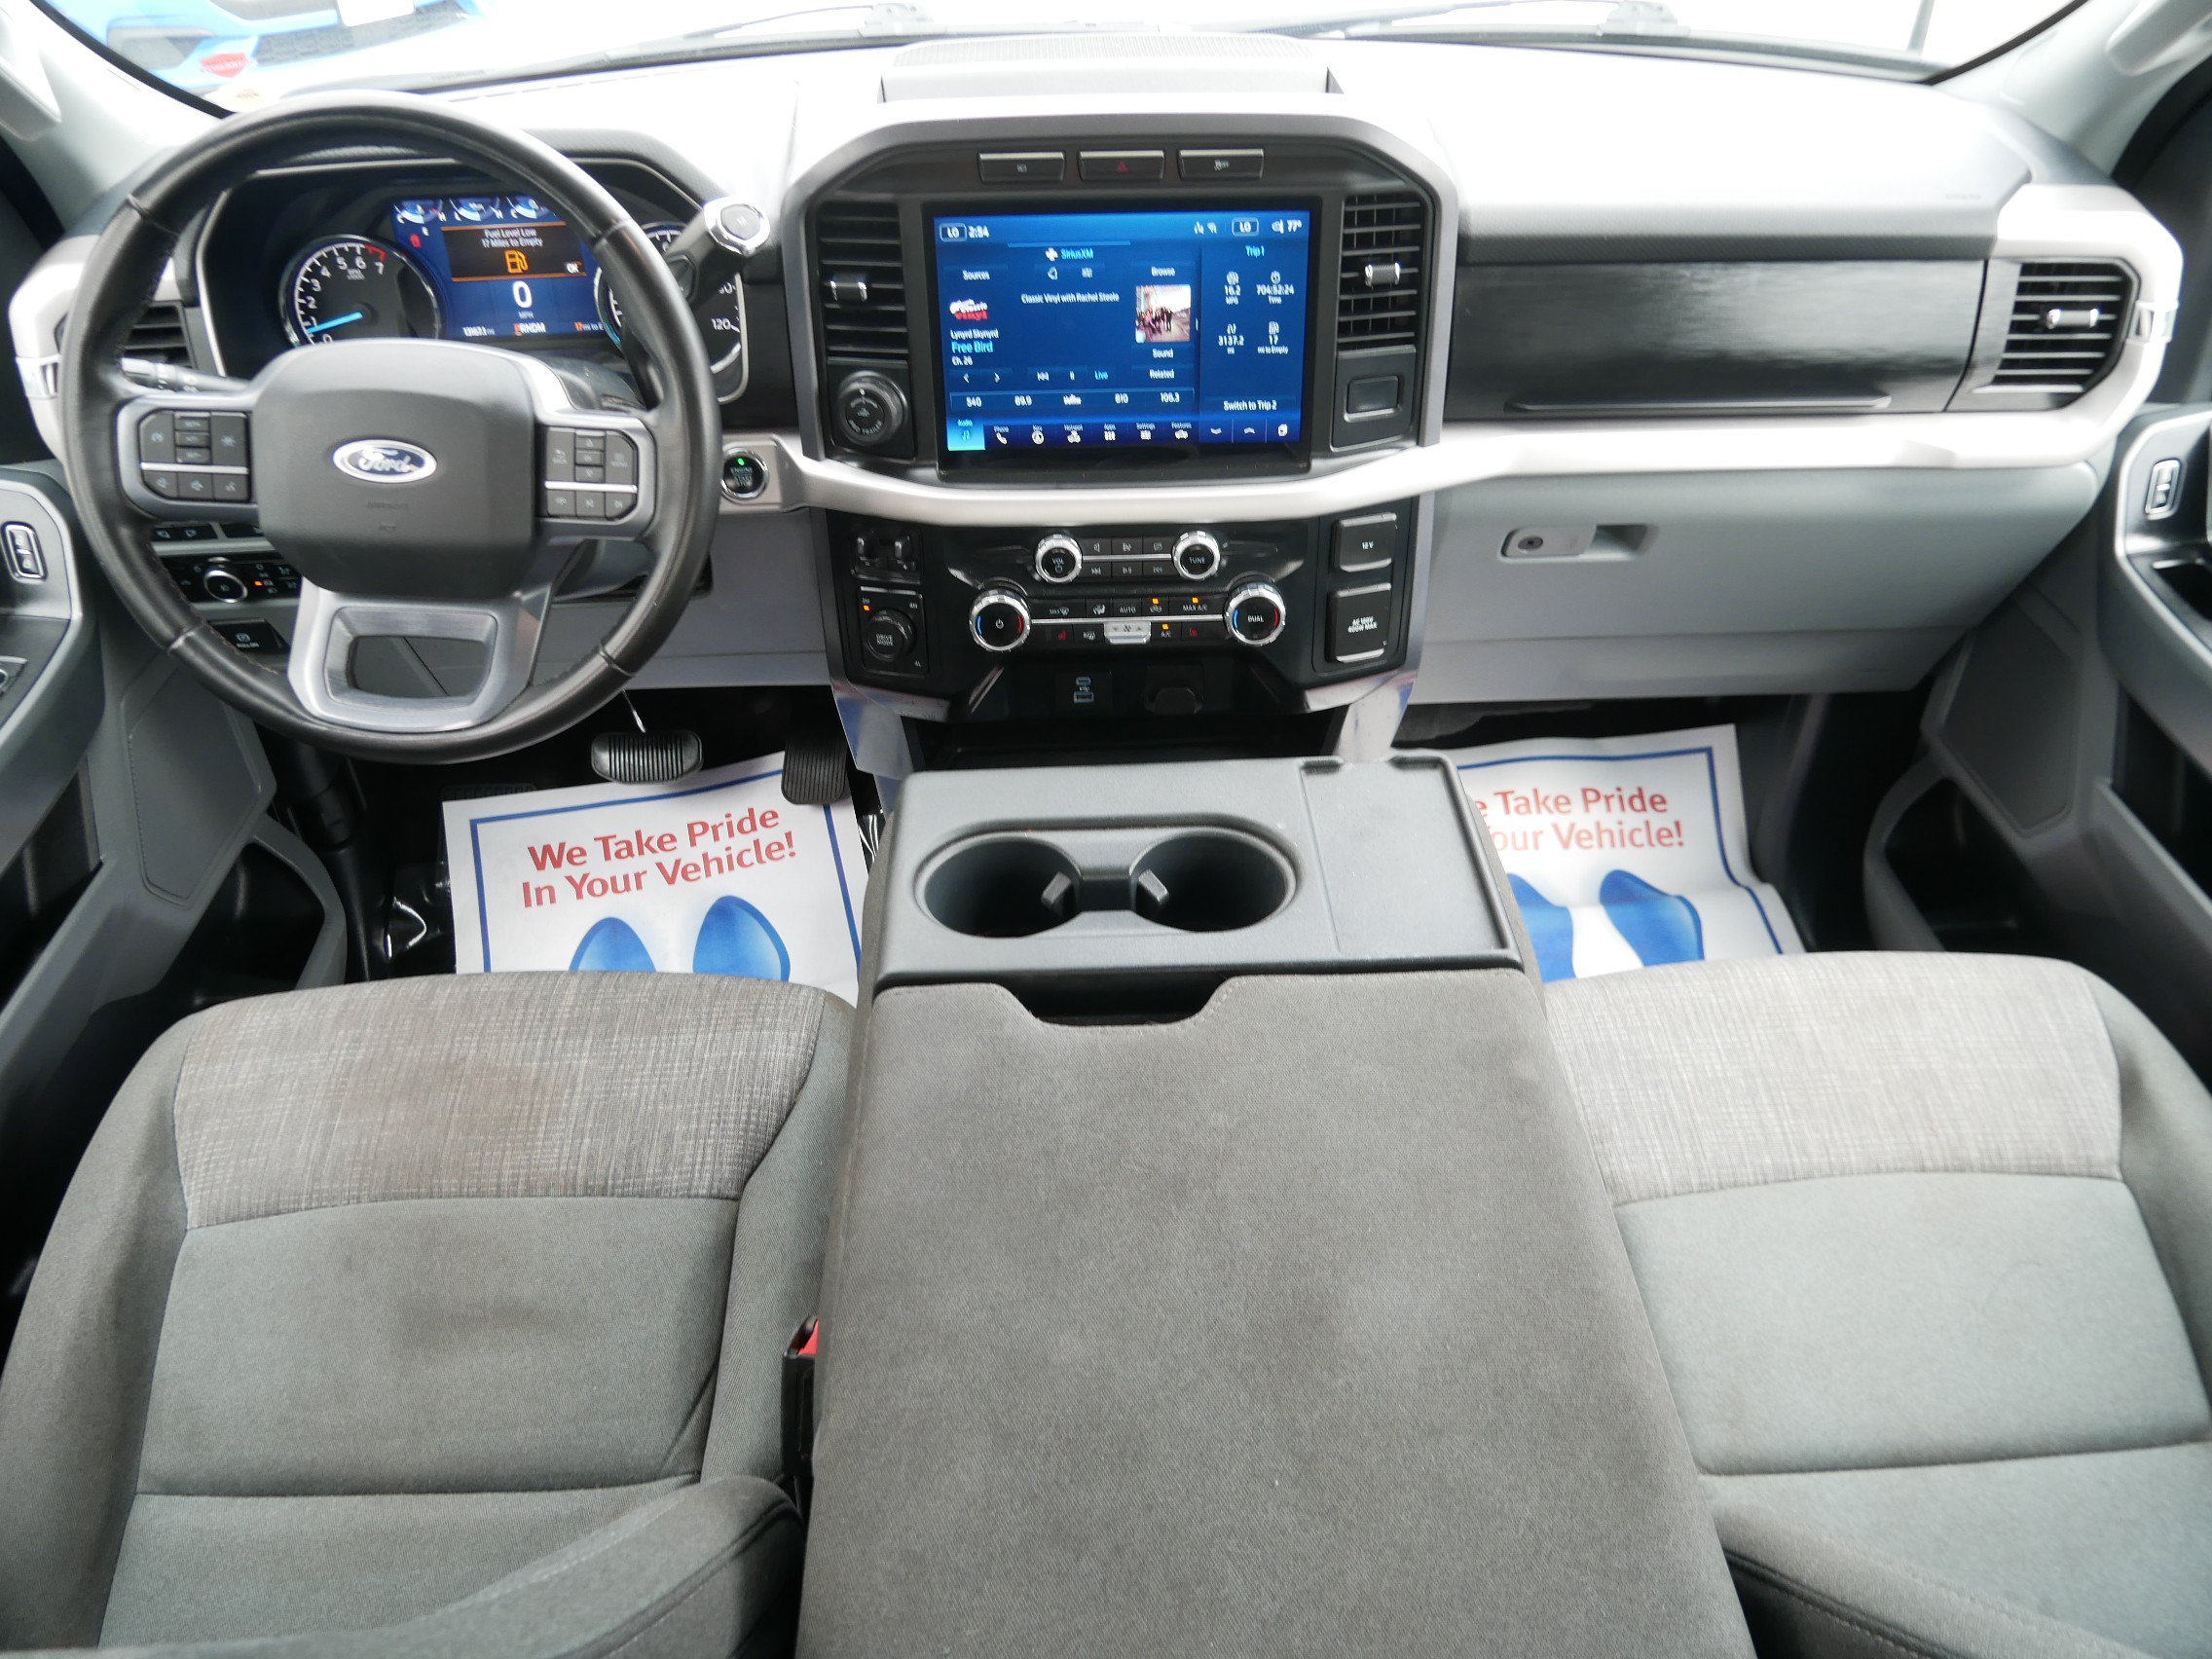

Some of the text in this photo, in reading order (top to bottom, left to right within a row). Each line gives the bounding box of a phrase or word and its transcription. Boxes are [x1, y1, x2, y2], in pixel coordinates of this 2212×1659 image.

[521, 228, 537, 238] Low
[1060, 248, 1094, 260] SiriusXM
[1245, 245, 1260, 258] Trip
[337, 257, 348, 270] 5
[354, 256, 366, 269] 6
[374, 261, 384, 275] 7
[320, 265, 331, 278] 4
[962, 270, 991, 280] Sources
[1151, 266, 1176, 276] Browse
[310, 278, 321, 292] 3
[512, 279, 533, 309] 0
[1020, 292, 1120, 305] Classic Vinyl with Rachel Steele
[306, 296, 317, 309] 2
[711, 317, 731, 331] 120
[951, 340, 994, 353] Free Bird
[1152, 348, 1174, 358] Sound
[1094, 370, 1109, 381] Live
[1149, 369, 1175, 380] Related
[1223, 399, 1248, 411] Switch
[1248, 399, 1257, 411] to
[1257, 399, 1272, 412] Trip
[356, 446, 416, 473] Ford
[1189, 556, 1206, 565] TUNE
[1119, 606, 1137, 614] AUTO
[1182, 604, 1208, 612] MAX A/C
[1247, 614, 1265, 624] DUAL
[1493, 788, 1571, 816] Take
[1581, 787, 1669, 814] Pride
[527, 807, 780, 871] We Take Pride
[1487, 821, 1685, 852] our Vehicle!
[522, 830, 797, 908] In Your Vehicle!
